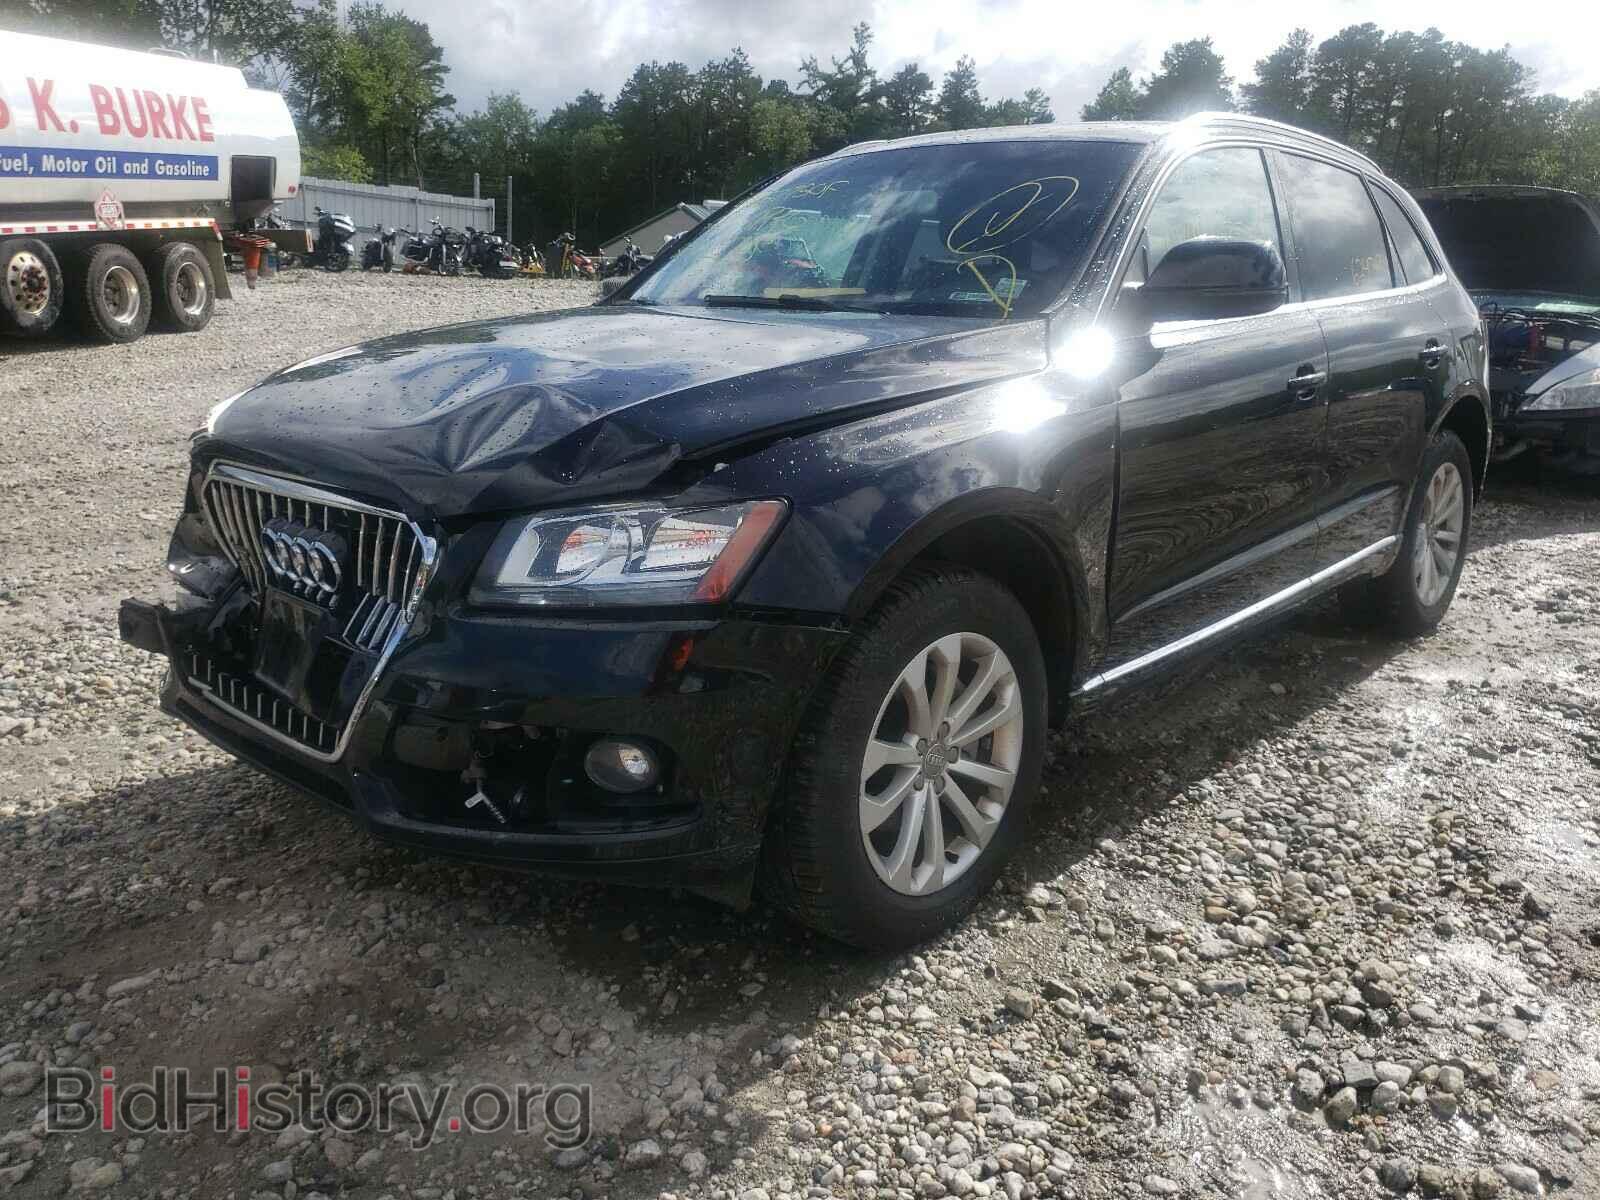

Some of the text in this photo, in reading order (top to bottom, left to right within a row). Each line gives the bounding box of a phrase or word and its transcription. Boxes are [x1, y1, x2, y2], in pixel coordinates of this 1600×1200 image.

[26, 77, 79, 134] K.
[89, 84, 215, 142] BURKE
[0, 153, 209, 177] uel, Motor Oil and Gasoline
